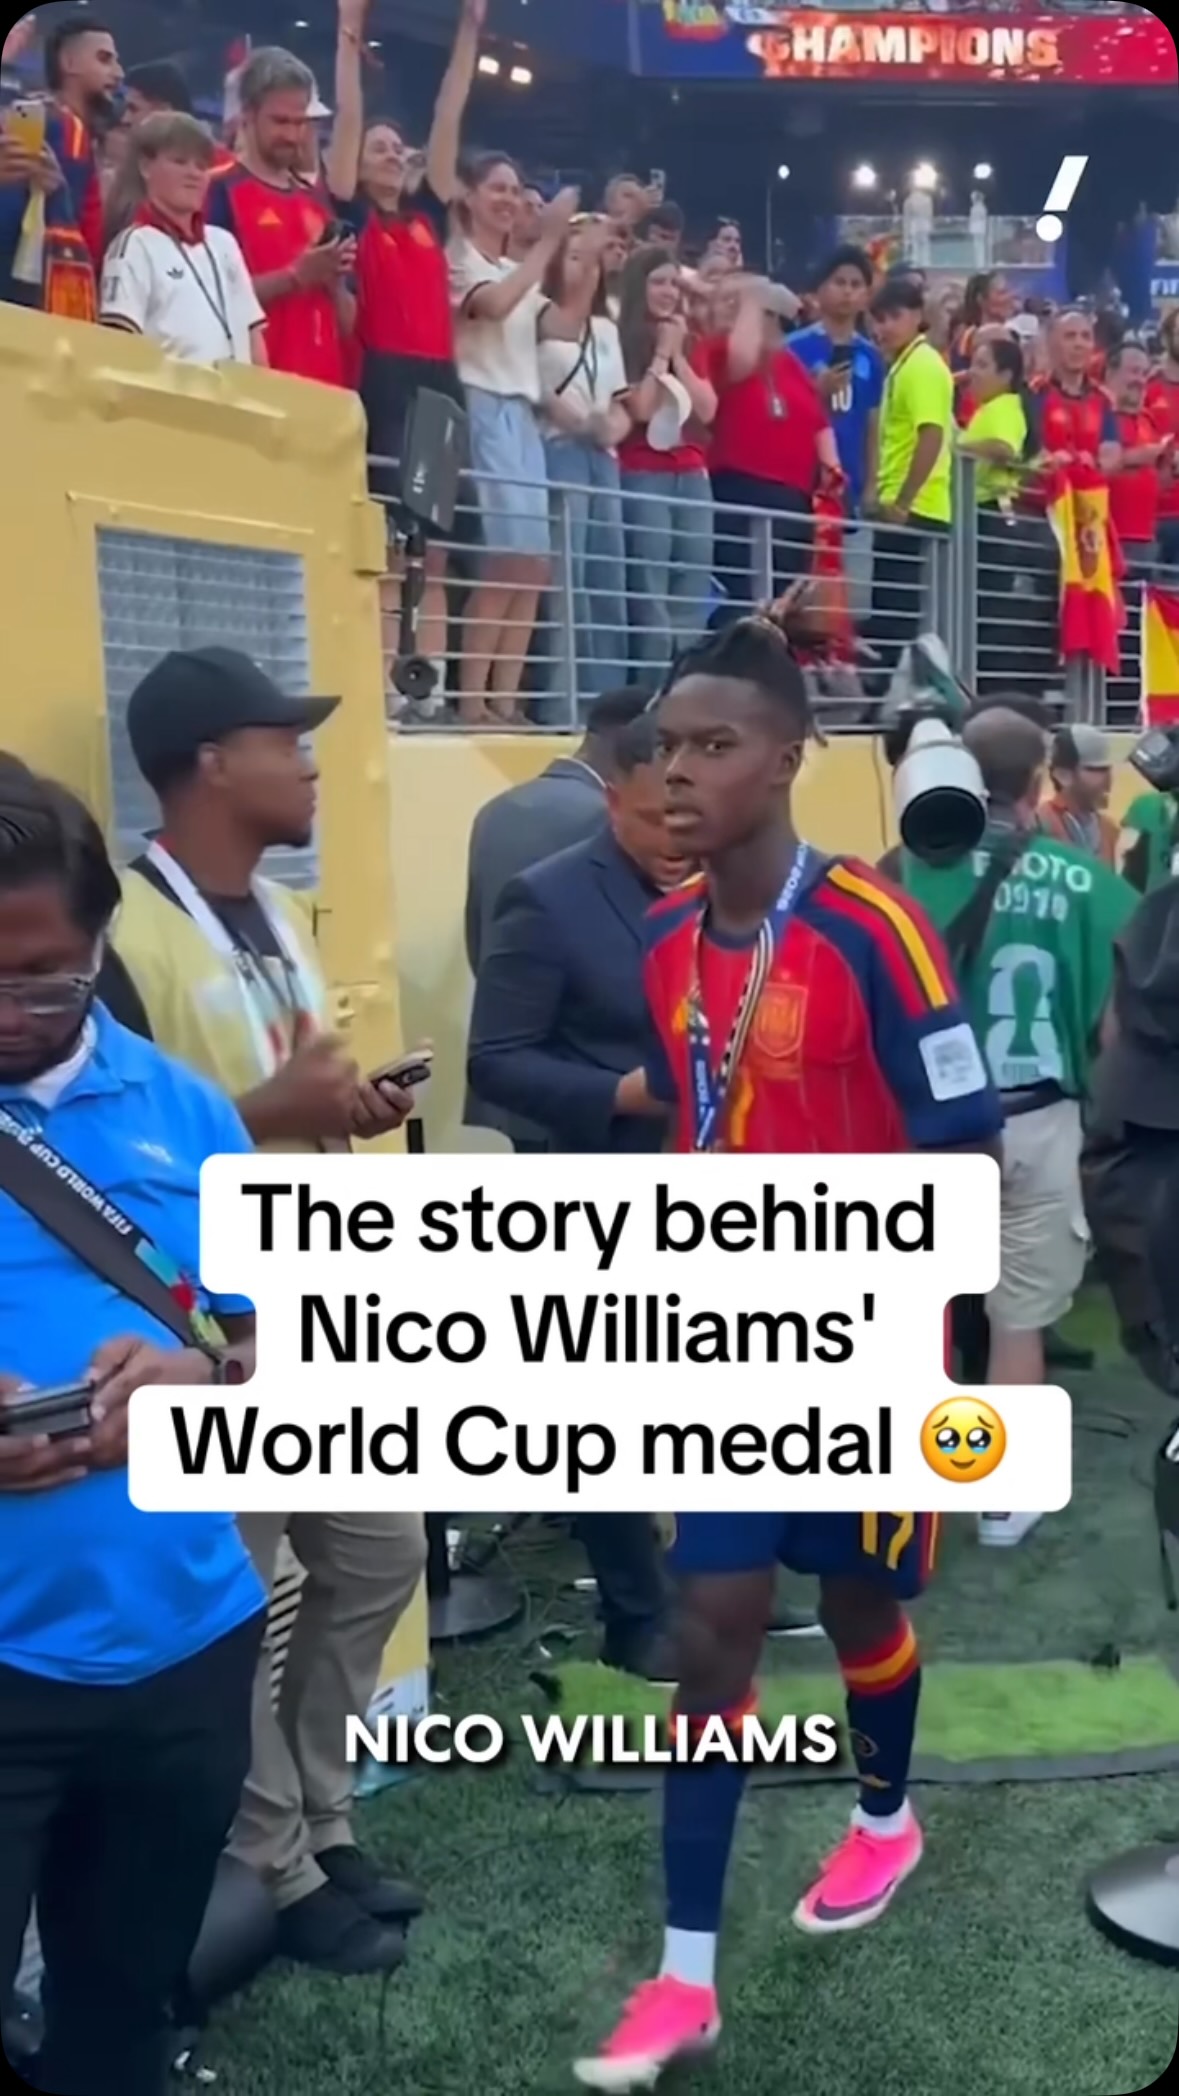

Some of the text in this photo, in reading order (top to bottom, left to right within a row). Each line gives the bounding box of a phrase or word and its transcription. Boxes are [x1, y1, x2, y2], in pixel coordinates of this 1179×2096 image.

[763, 26, 1059, 66] CHAMPIONS
[972, 851, 1092, 892] POTO
[29, 1143, 133, 1235] FIFA WORLD CUP
[862, 1512, 914, 1571] 17
